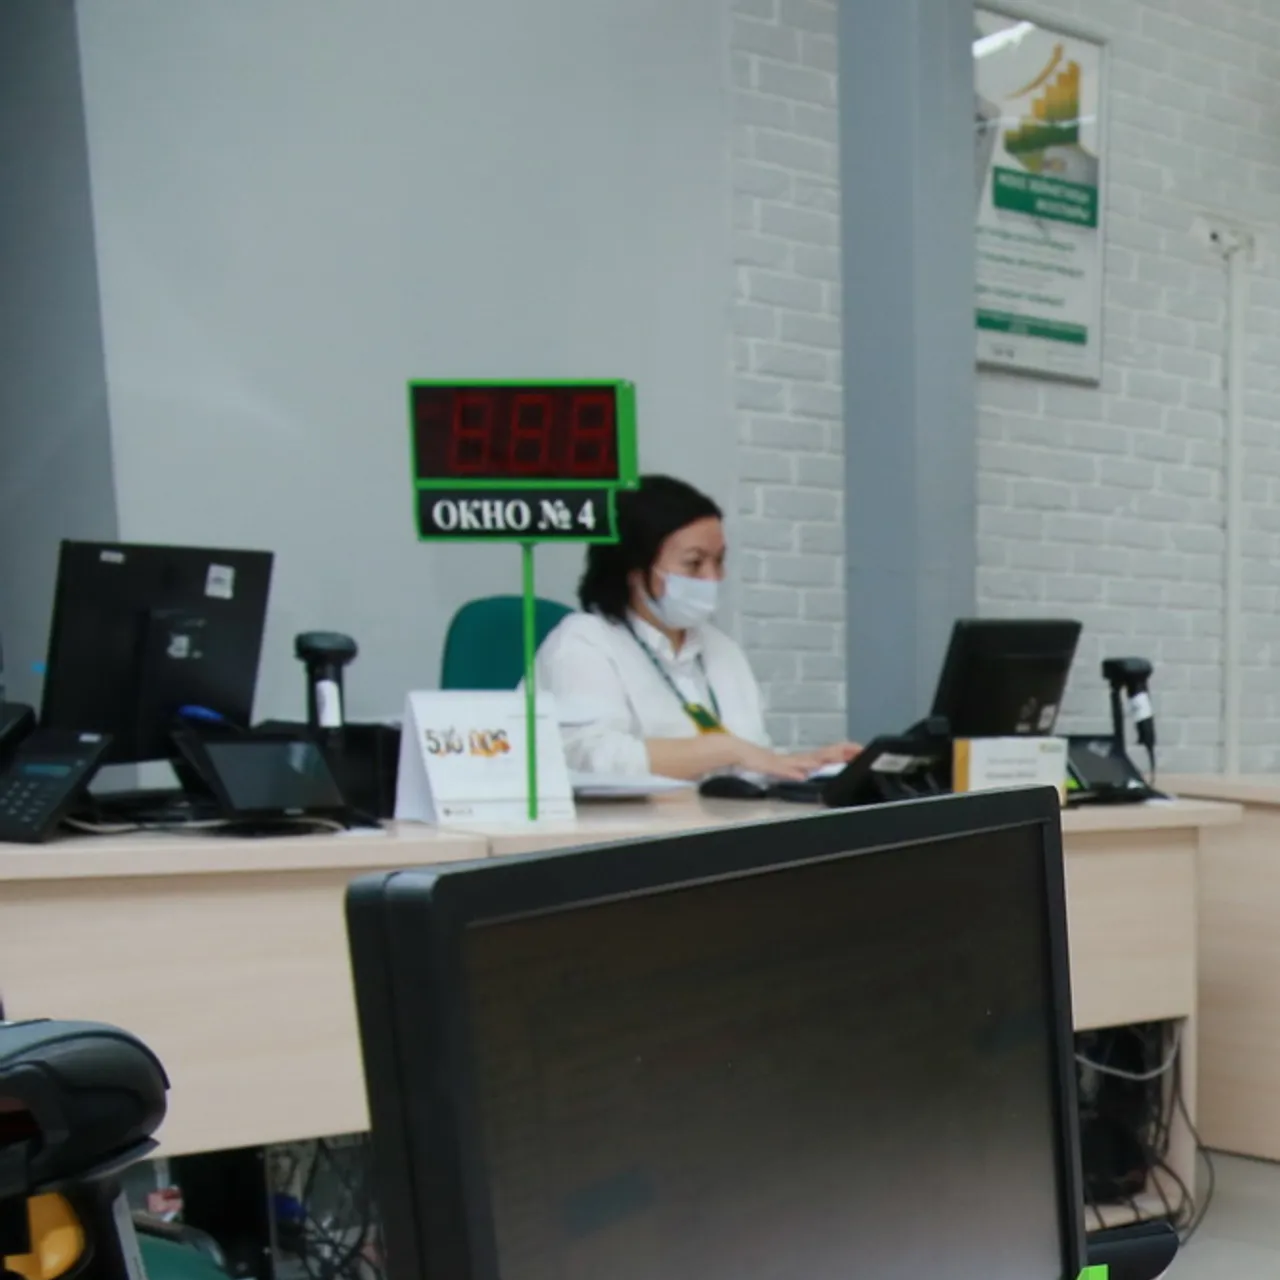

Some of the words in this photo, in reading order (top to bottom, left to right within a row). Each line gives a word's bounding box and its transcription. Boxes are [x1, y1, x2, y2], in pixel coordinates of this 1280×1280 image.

[432, 498, 531, 531] ОКНО
[538, 498, 573, 531] №
[577, 498, 597, 530] 4
